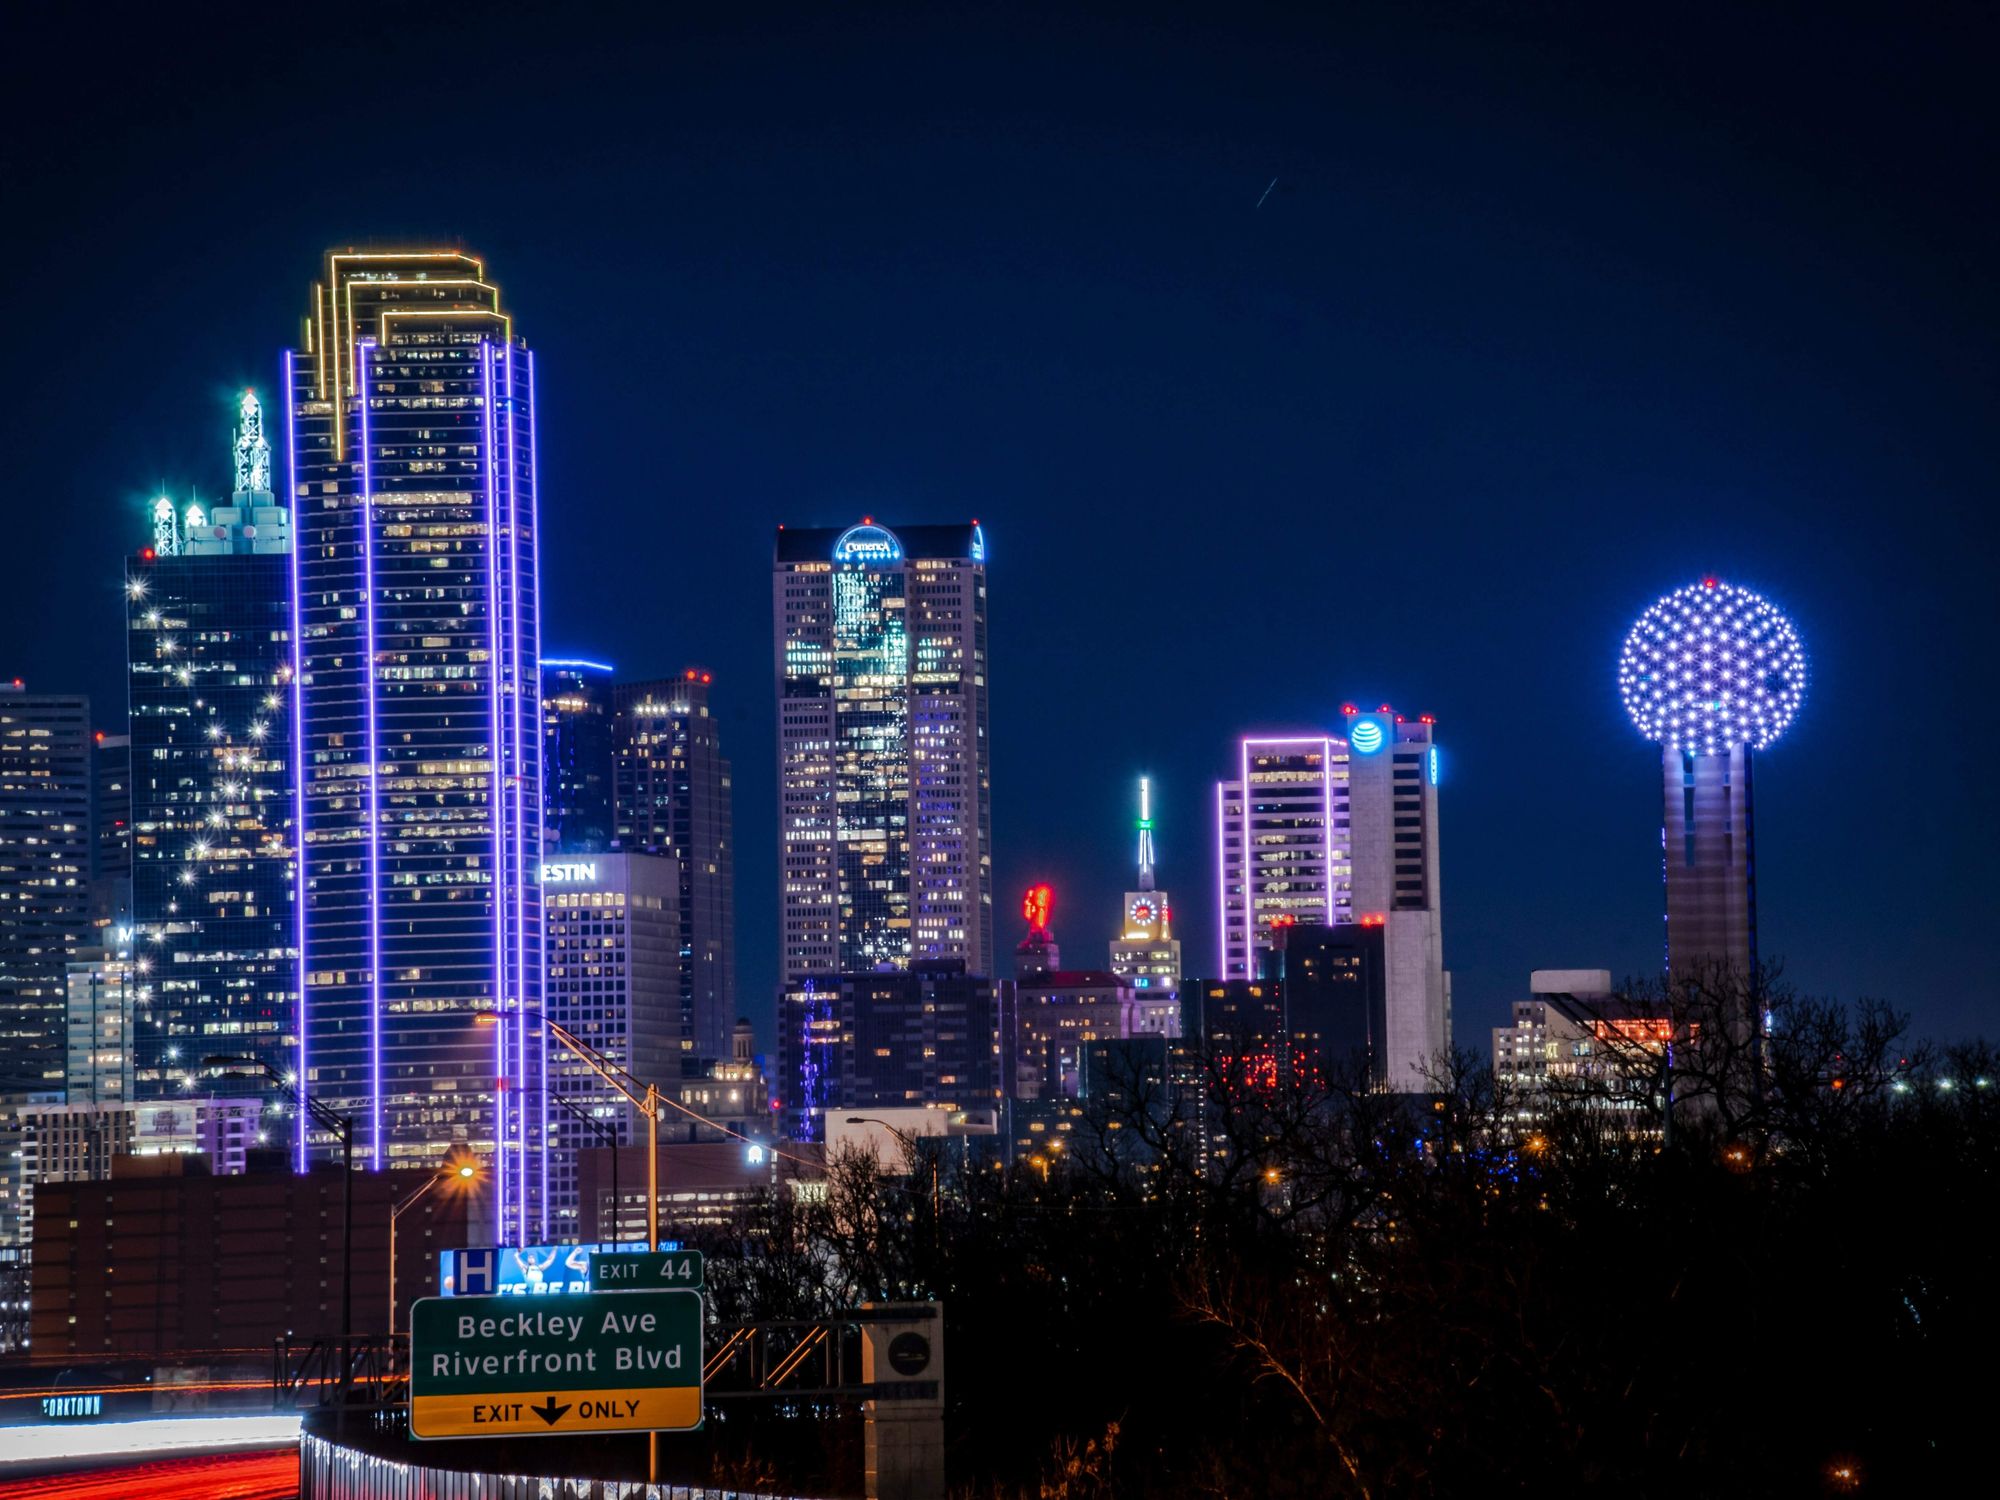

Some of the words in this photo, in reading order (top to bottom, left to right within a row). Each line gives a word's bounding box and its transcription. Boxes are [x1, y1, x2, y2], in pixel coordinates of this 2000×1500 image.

[540, 863, 596, 881] ESTIN
[459, 1251, 493, 1293] H
[600, 1263, 639, 1280] EXIT
[659, 1258, 693, 1280] 44
[458, 1312, 584, 1342] Beckley
[600, 1311, 657, 1335] Ave
[432, 1348, 597, 1377] Riverfront
[615, 1344, 682, 1371] Blvd
[42, 1395, 101, 1417] YORKTOWN
[473, 1404, 524, 1424] EXIT
[578, 1400, 641, 1420] ONLY
